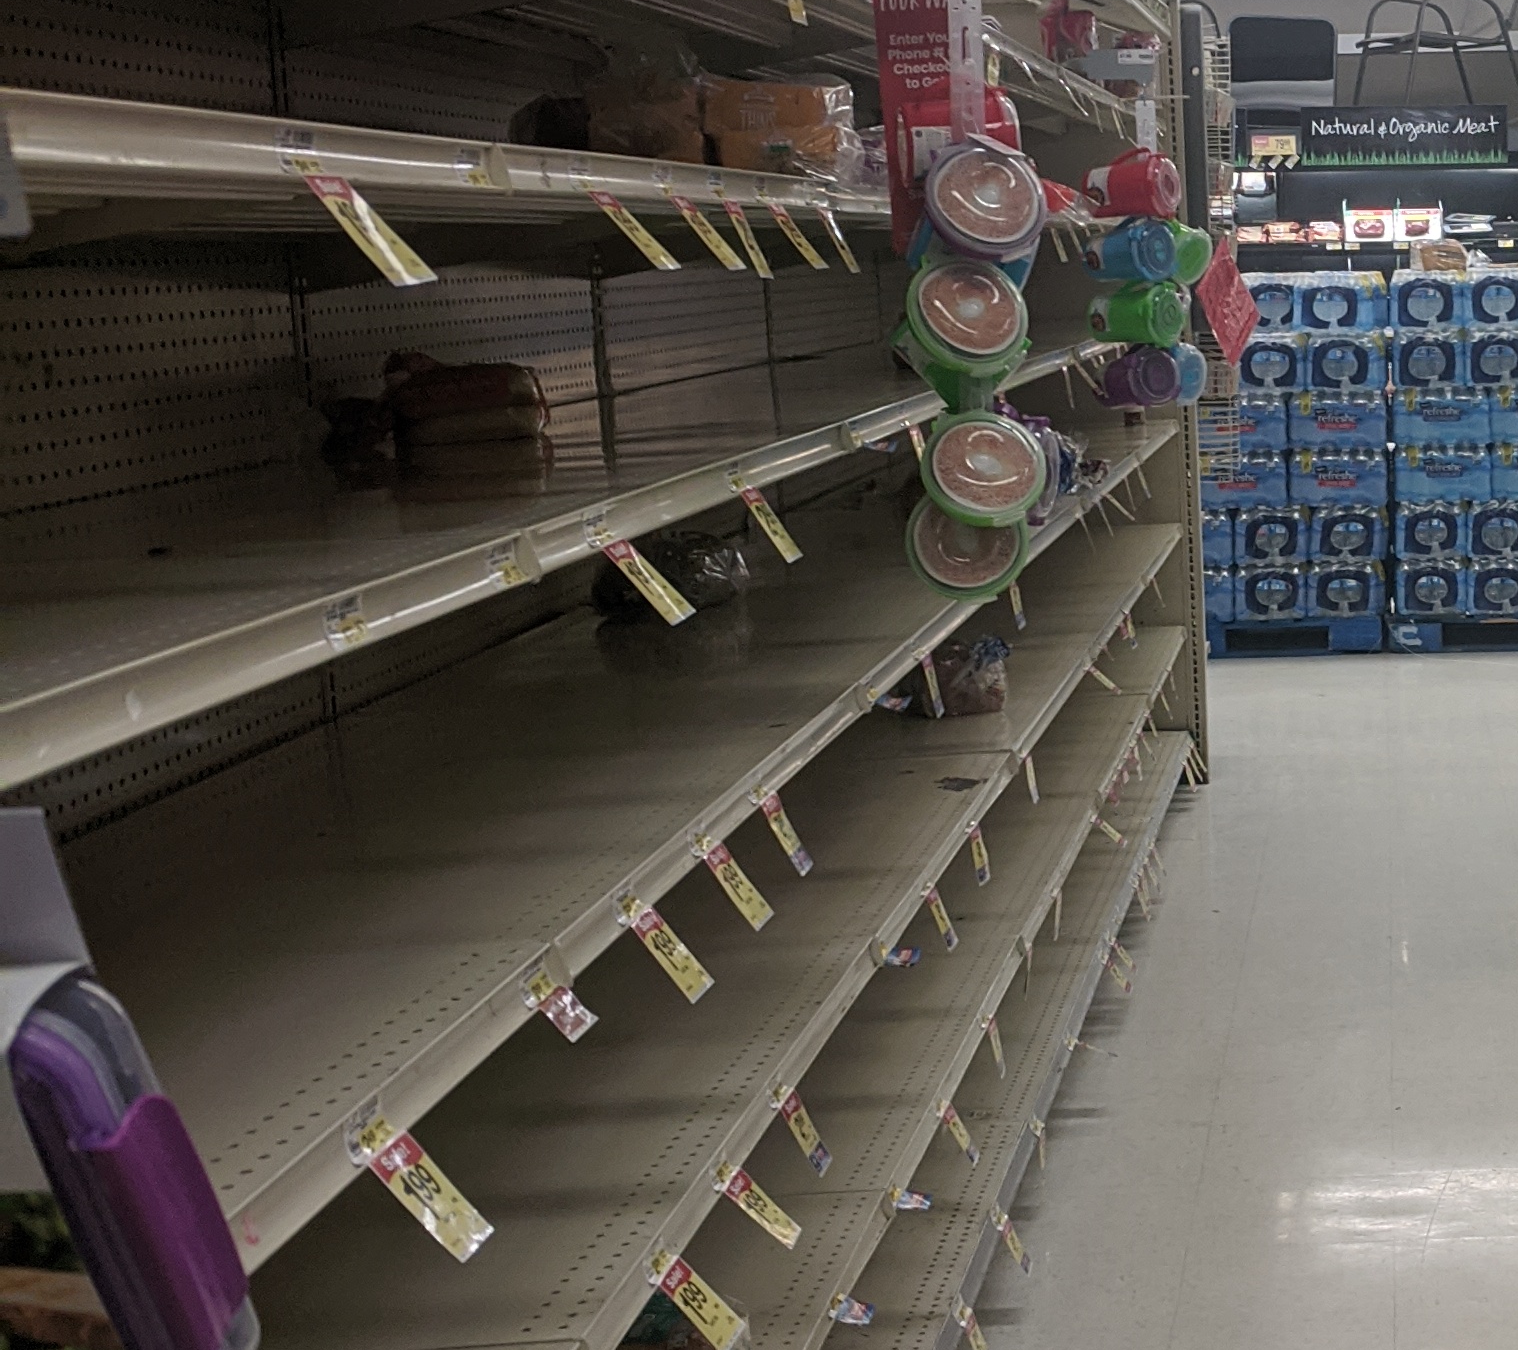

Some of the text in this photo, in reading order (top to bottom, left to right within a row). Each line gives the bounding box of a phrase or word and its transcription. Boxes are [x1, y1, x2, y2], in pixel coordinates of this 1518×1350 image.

[889, 33, 923, 45] Enter
[888, 49, 929, 61] Phone
[905, 77, 919, 89] to
[1311, 115, 1499, 142] Natural & Organic Meat
[400, 1163, 441, 1221] 199
[679, 1280, 708, 1325] 199
